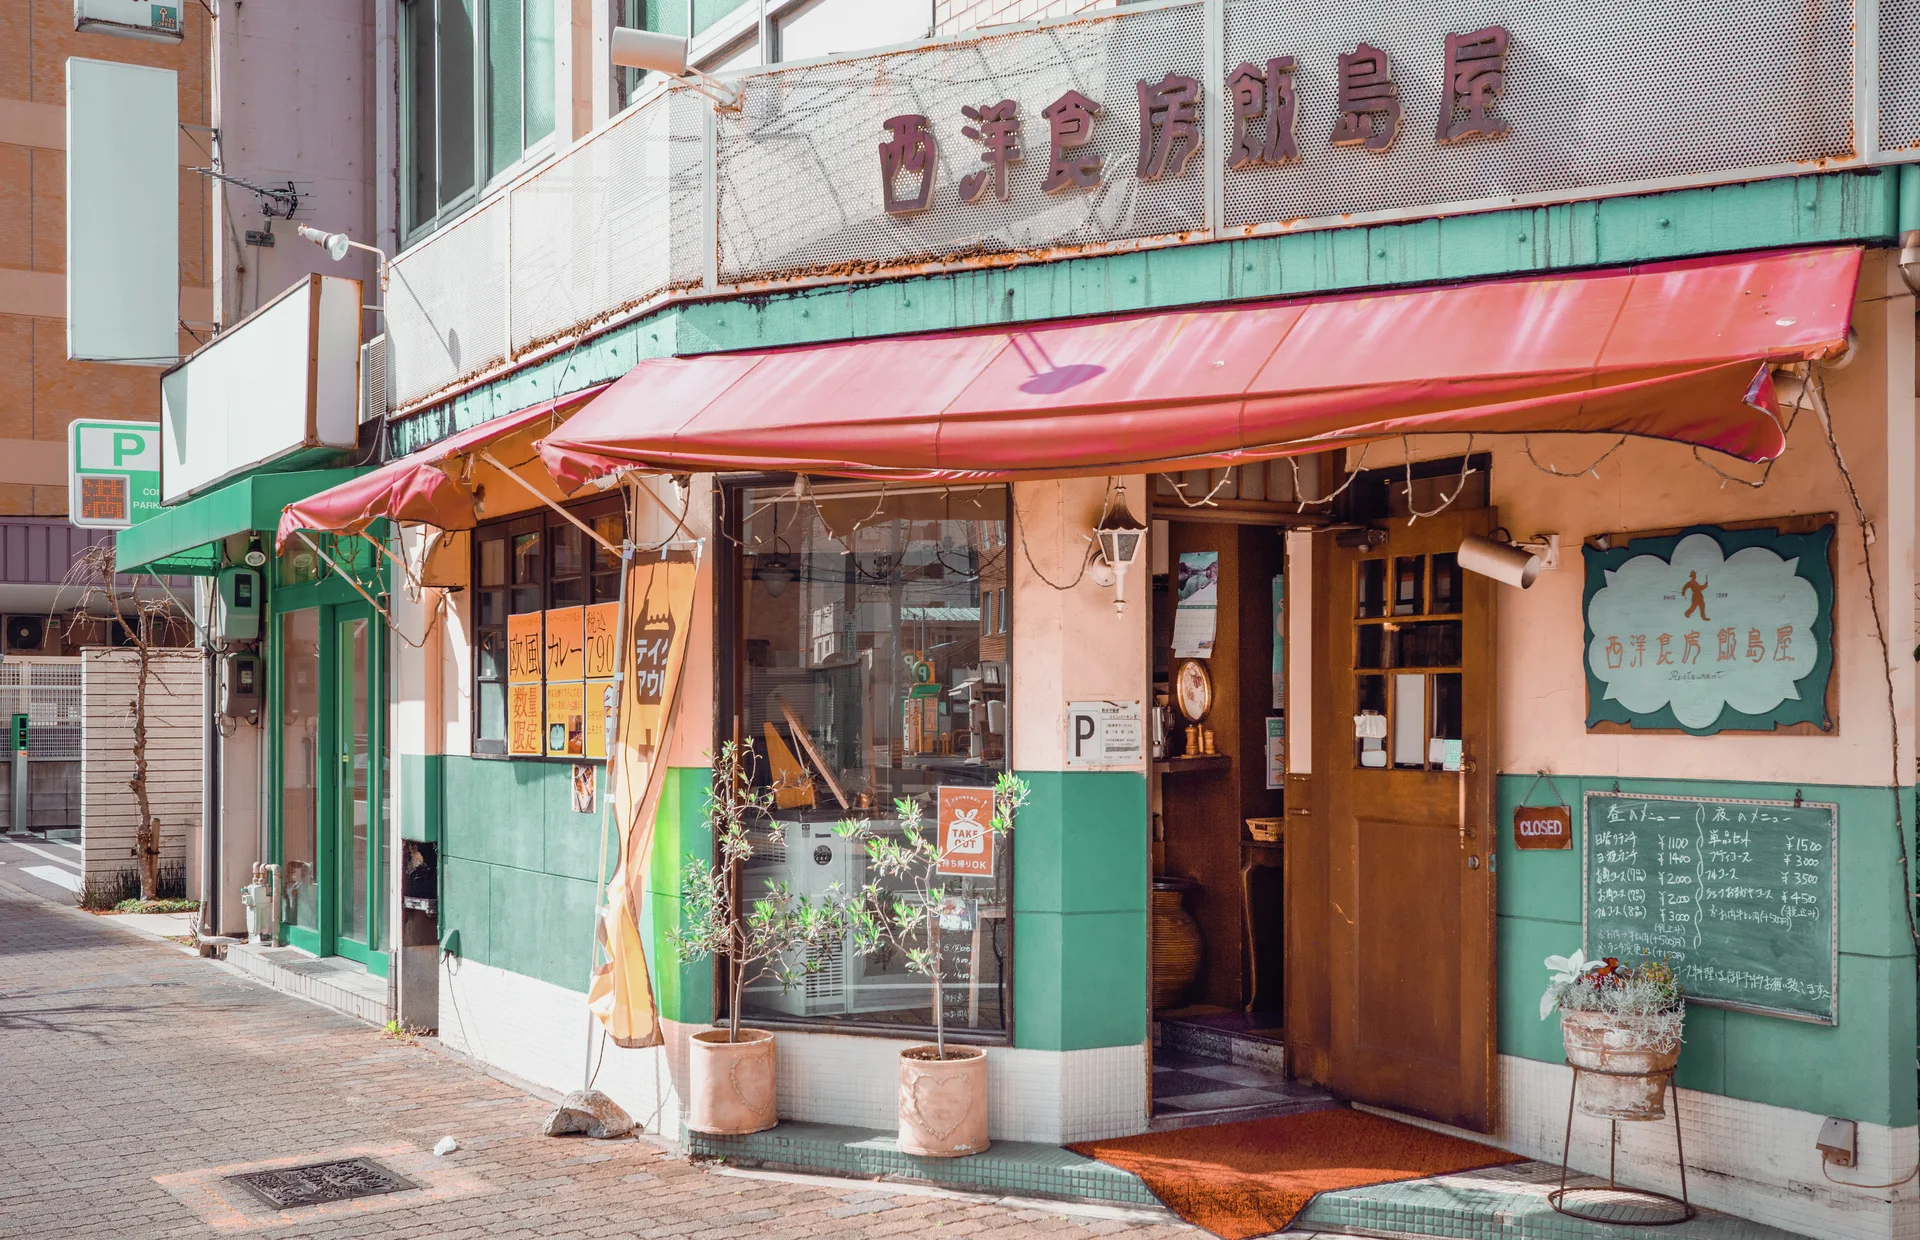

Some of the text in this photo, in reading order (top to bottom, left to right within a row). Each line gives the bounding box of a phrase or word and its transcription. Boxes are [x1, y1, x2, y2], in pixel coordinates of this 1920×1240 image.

[113, 432, 146, 466] P
[82, 479, 124, 519] 満
[143, 488, 160, 496] COI
[587, 611, 606, 633] 税込
[587, 635, 614, 673] 790
[1668, 670, 1725, 681] Restaurant
[513, 687, 538, 718] 数量
[513, 719, 538, 750] 限定
[1075, 715, 1095, 757] P
[952, 829, 979, 839] TAKE
[1520, 819, 1562, 836] CLOSED
[954, 839, 976, 848] OUT
